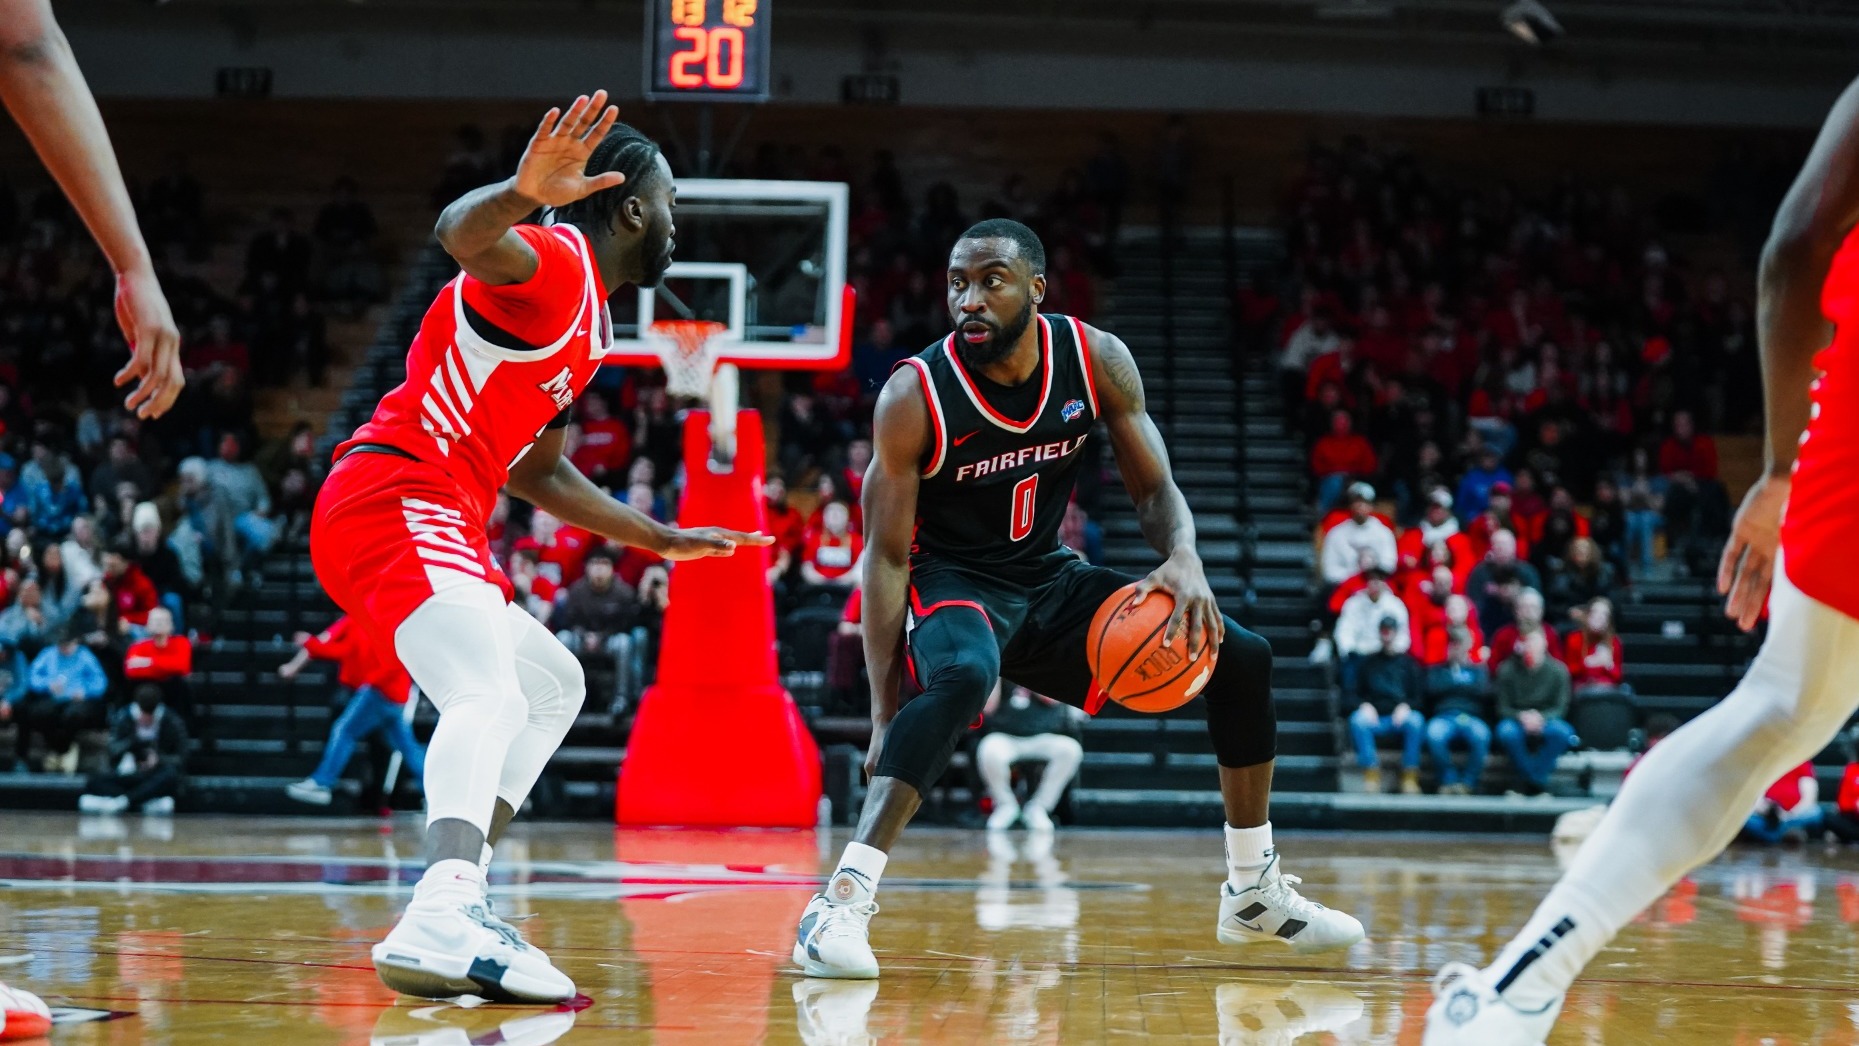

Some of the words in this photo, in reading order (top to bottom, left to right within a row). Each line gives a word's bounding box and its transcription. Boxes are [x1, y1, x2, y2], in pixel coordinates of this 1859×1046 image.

[669, 26, 745, 89] 20
[956, 433, 1088, 482] FAIRFIELD
[1010, 472, 1039, 542] 0
